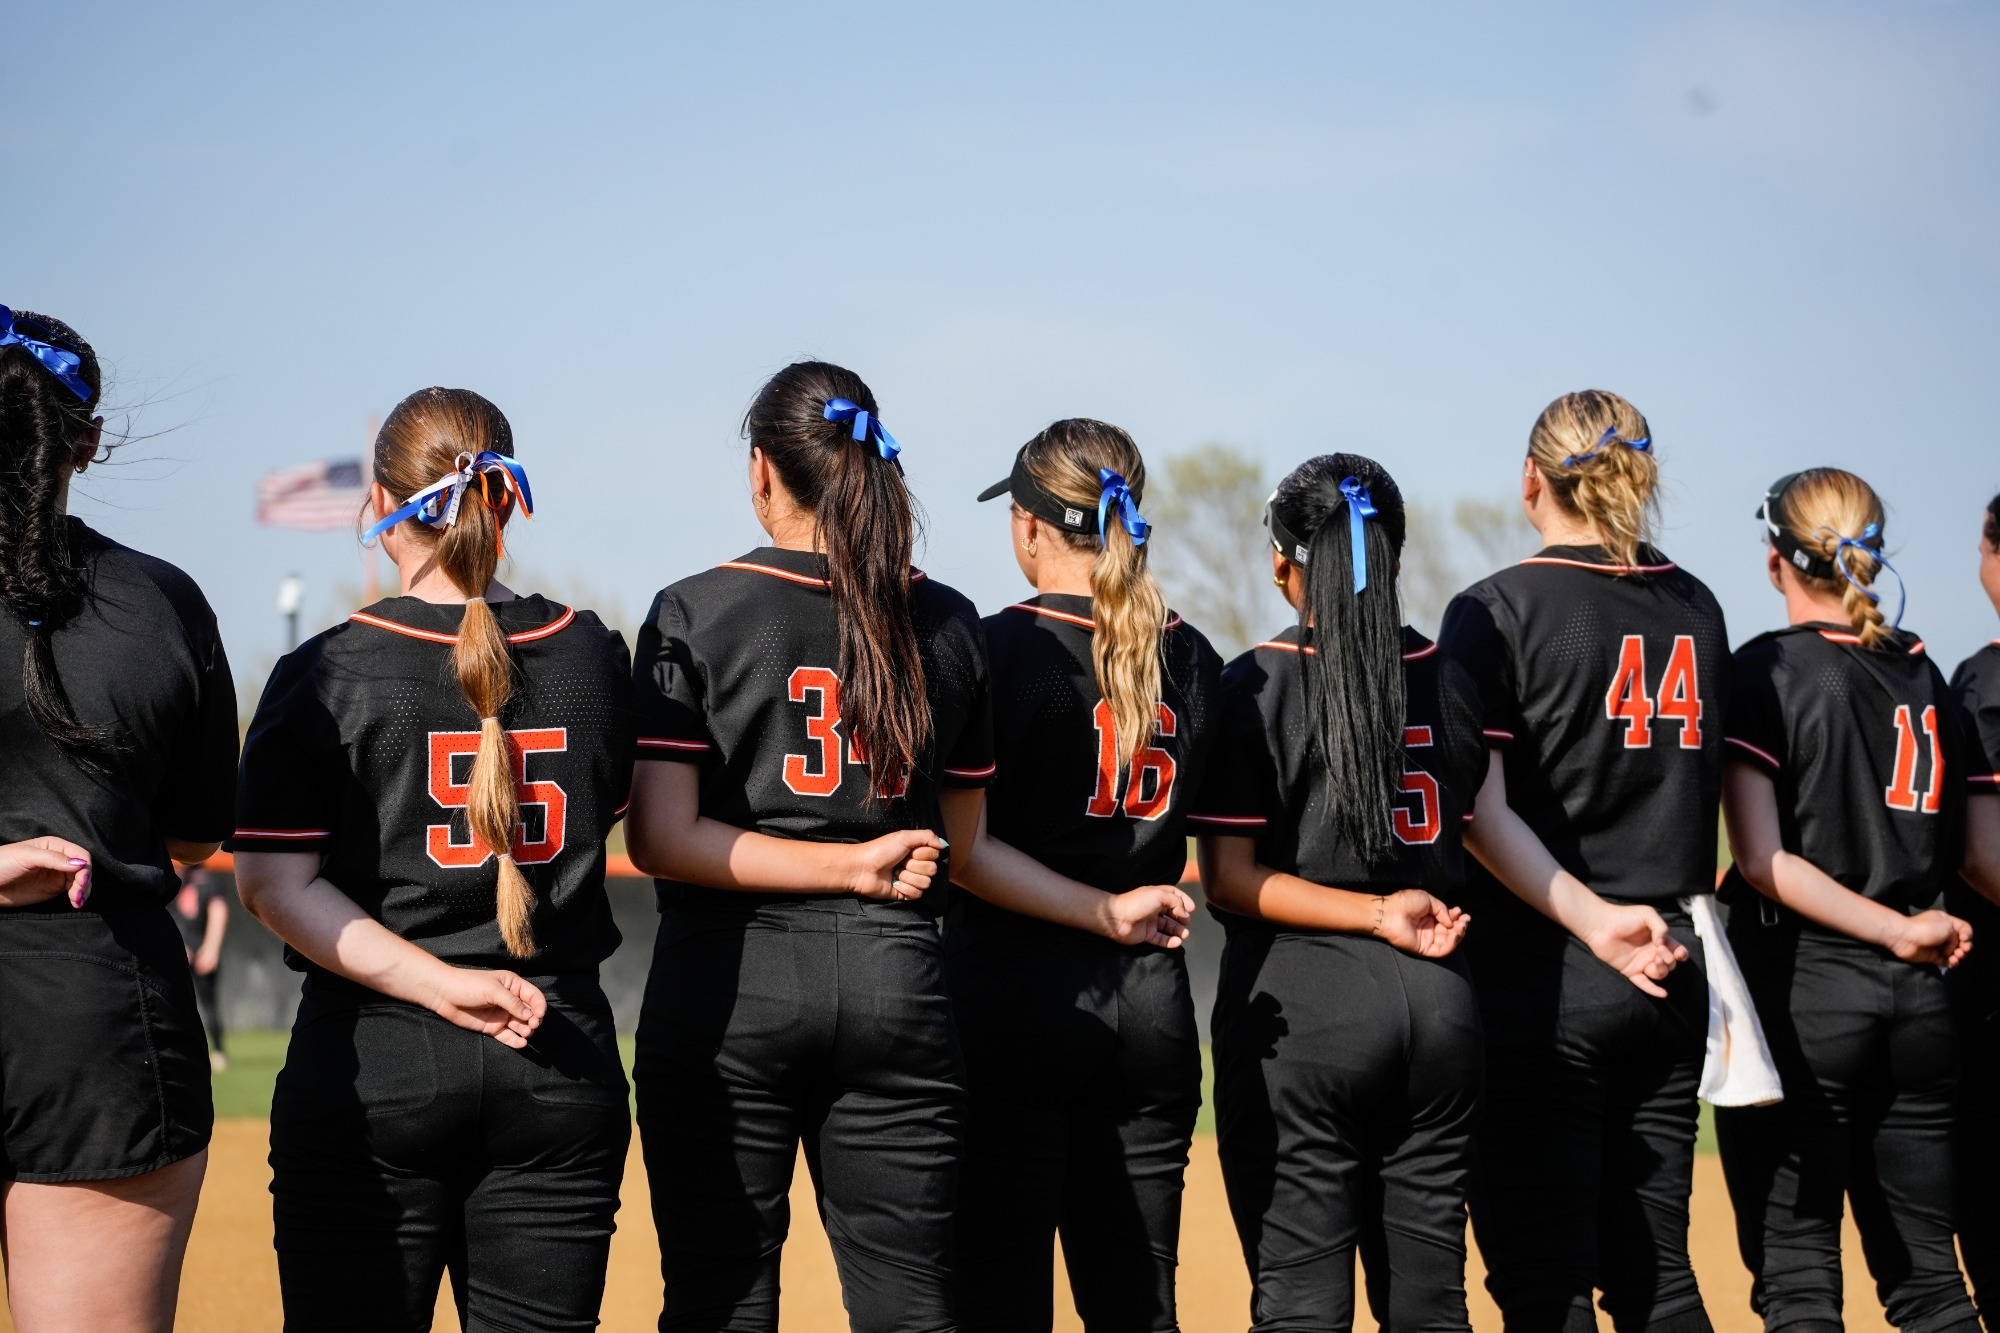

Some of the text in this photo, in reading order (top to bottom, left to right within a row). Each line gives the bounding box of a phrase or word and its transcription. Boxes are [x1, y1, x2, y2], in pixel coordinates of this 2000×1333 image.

[782, 666, 912, 799] 3
[1605, 634, 1703, 749] 44
[426, 727, 567, 868] 55
[1085, 698, 1177, 821] 16
[1885, 704, 1945, 814] 11
